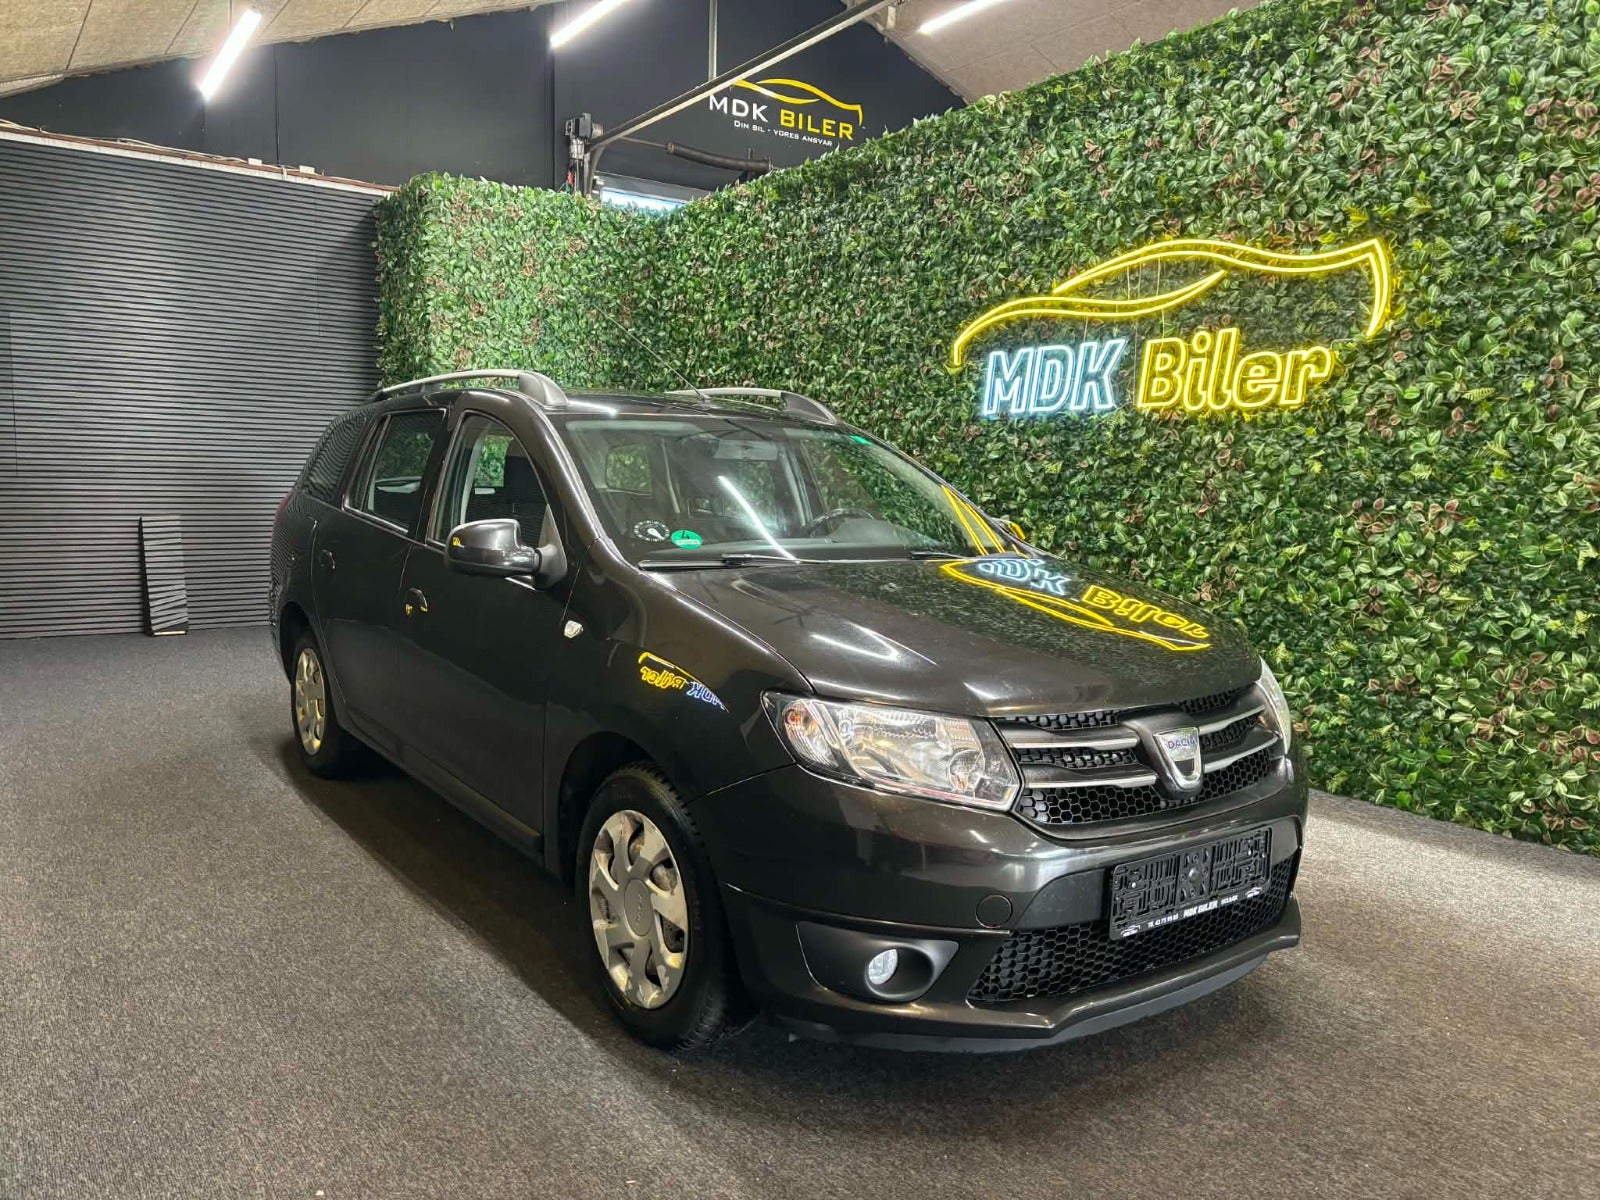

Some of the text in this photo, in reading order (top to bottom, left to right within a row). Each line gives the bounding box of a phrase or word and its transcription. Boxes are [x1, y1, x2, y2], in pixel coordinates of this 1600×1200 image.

[709, 94, 853, 140] MDK BILER
[752, 124, 765, 133] BIL
[773, 129, 799, 140] VORES
[801, 135, 833, 147] ANSVAR
[983, 327, 1333, 416] MDK Biler
[1167, 736, 1198, 749] DACIA
